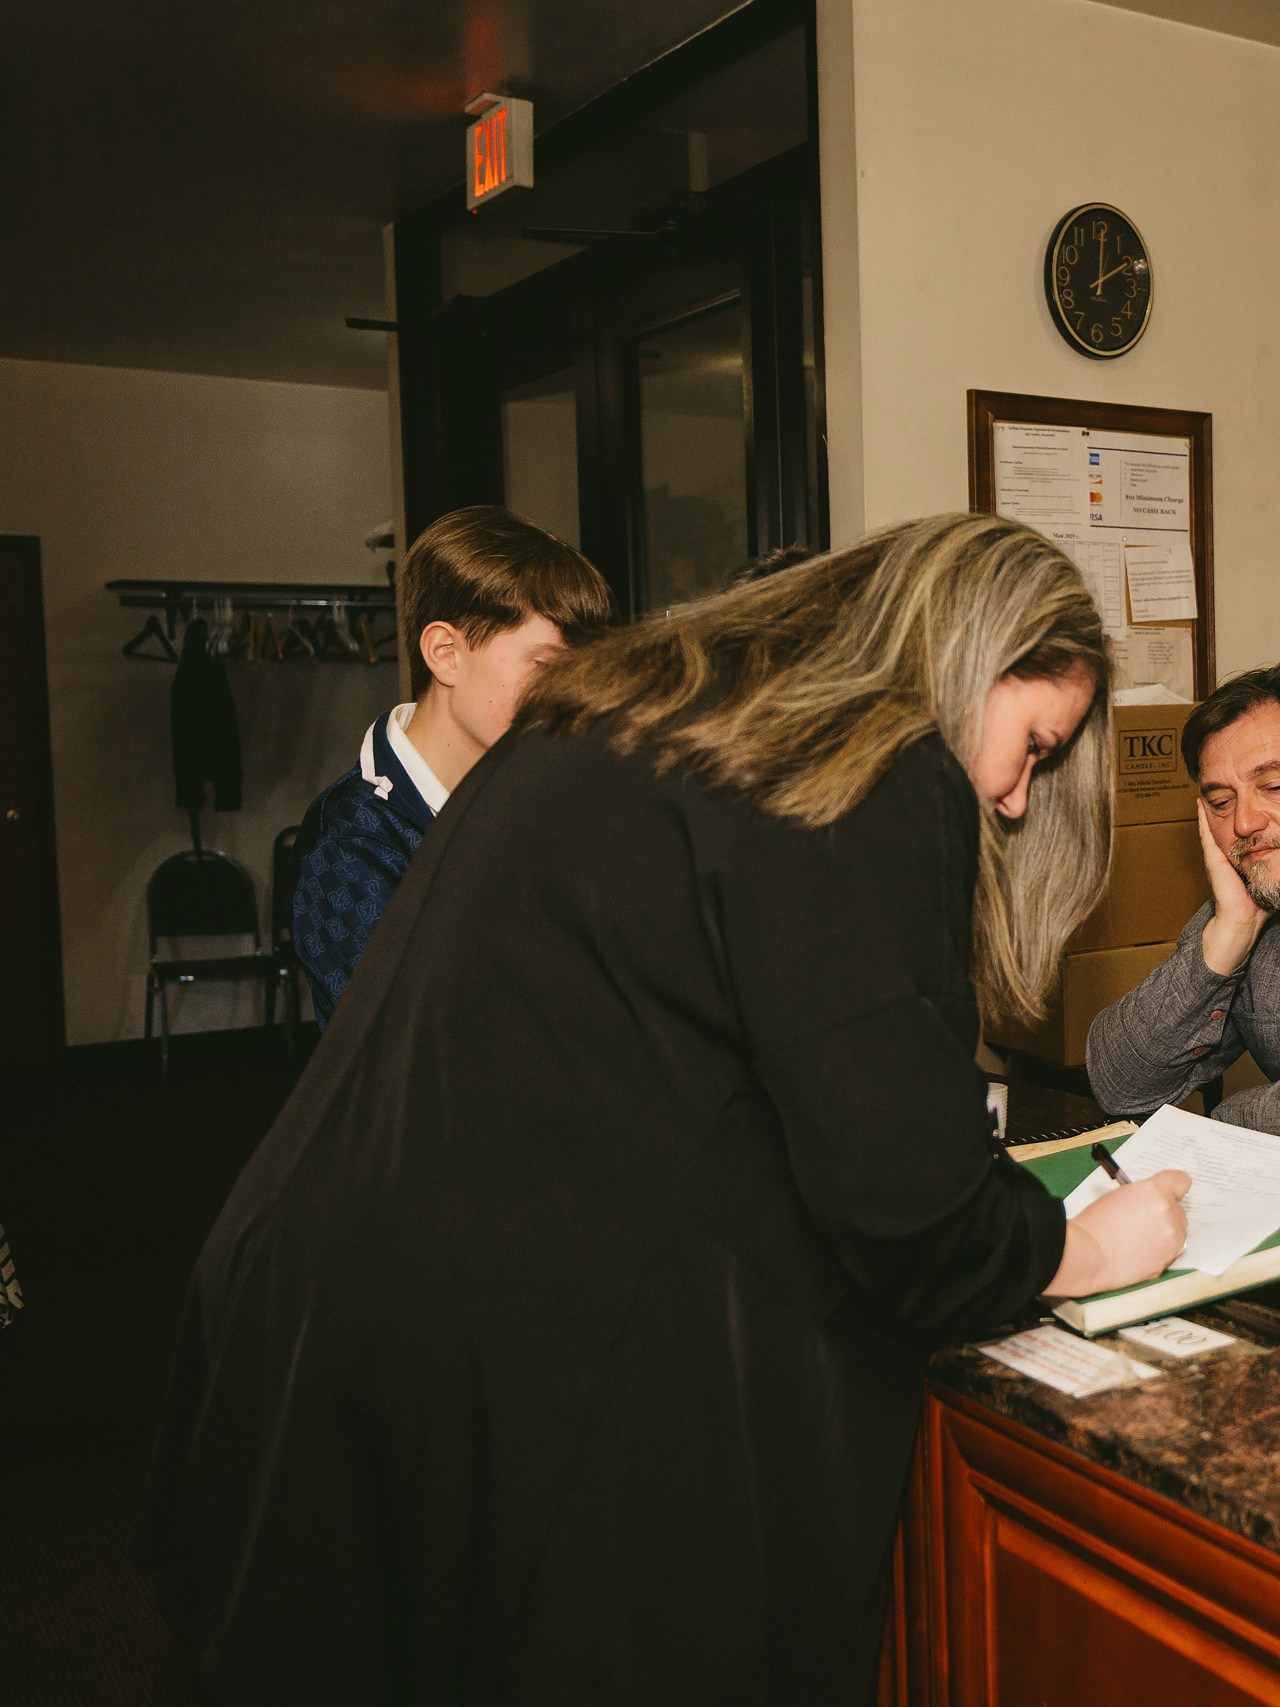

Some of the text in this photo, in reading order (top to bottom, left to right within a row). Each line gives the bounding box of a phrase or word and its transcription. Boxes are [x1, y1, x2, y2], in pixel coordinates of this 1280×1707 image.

[474, 108, 507, 197] EXIT
[1074, 226, 1084, 247] 11
[1062, 245, 1078, 265] 10
[1122, 256, 1133, 275] 2
[1058, 266, 1070, 286] 9
[1125, 278, 1137, 298] 3
[1061, 289, 1074, 309] 8
[1121, 300, 1132, 319] 4
[1074, 311, 1085, 330] 7
[1110, 317, 1122, 337] 5
[1091, 323, 1103, 343] 6
[1136, 494, 1163, 502] Minimum
[1123, 734, 1173, 757] TKC
